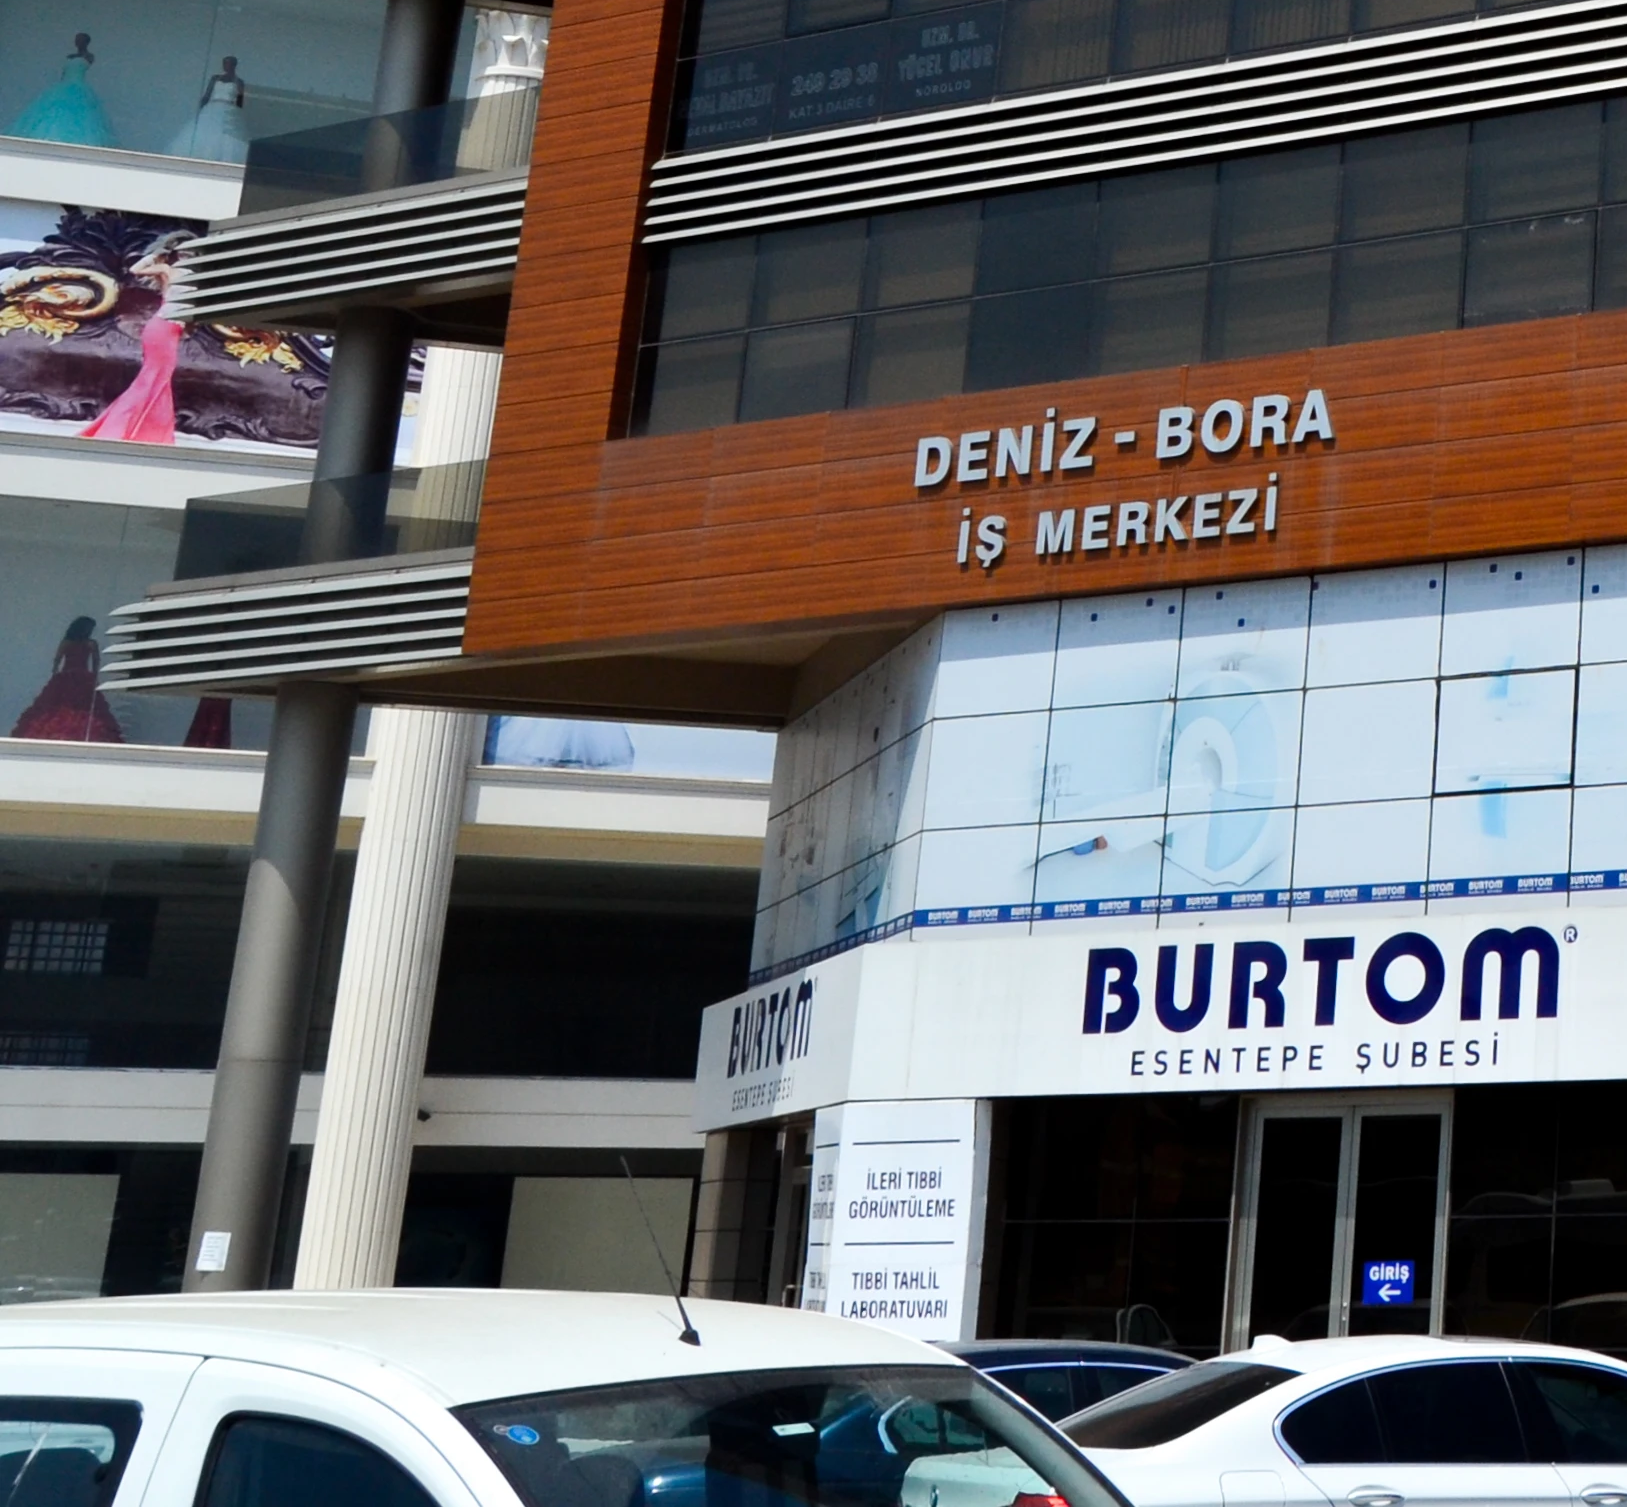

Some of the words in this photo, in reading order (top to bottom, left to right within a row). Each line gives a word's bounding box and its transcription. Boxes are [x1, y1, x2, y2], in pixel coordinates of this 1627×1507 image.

[914, 407, 1096, 487] DENİZ
[1114, 430, 1136, 445] -
[1156, 388, 1336, 460] BORA
[956, 507, 1007, 568] İŞ
[1035, 472, 1279, 555] MERKEZİ
[1082, 926, 1560, 1034] BURTOM
[727, 977, 813, 1079] BURTOM
[1131, 1045, 1324, 1077] ESENTEPE
[1356, 1031, 1500, 1073] ŞUBESİ
[867, 1167, 902, 1191] İLERİ
[907, 1166, 943, 1190] TIBBİ
[849, 1195, 956, 1219] GÖRÜNTÜLEME
[852, 1267, 888, 1290] TIBBİ
[893, 1266, 940, 1290] TAHLİL
[1369, 1262, 1410, 1284] GİRİŞ
[841, 1299, 949, 1319] LABORATUVARI
